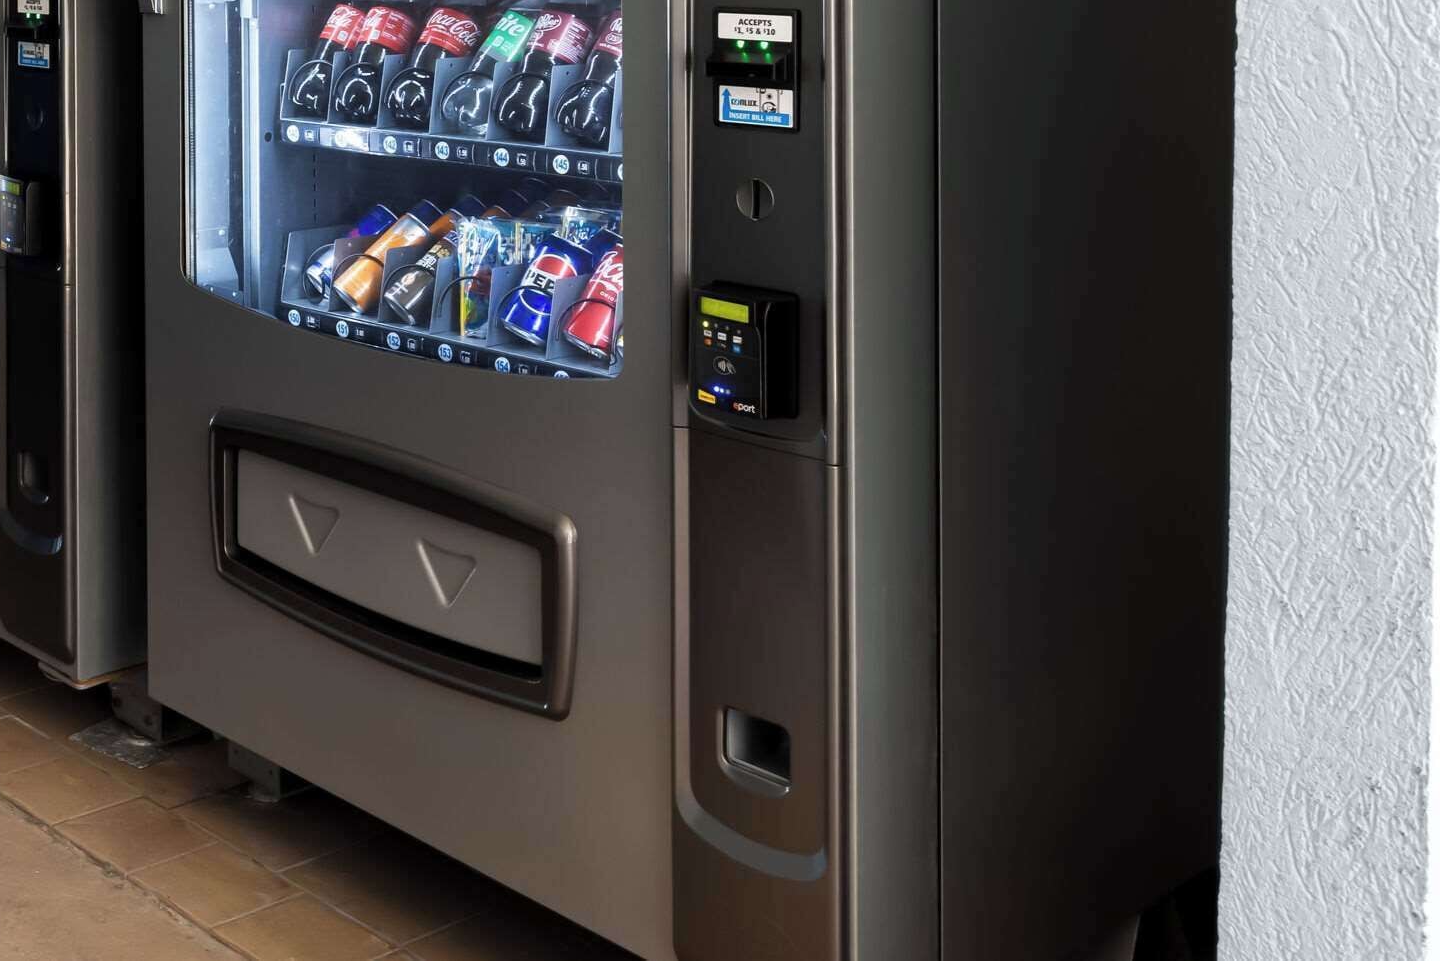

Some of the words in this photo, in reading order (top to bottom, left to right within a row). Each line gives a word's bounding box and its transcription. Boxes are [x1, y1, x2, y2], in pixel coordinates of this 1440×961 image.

[738, 18, 772, 27] ACCEPTS
[734, 27, 744, 35] $1,
[763, 28, 776, 36] $10
[729, 112, 750, 120] INSERT
[751, 114, 764, 122] BILL
[765, 115, 782, 123] HERE
[436, 146, 448, 157] 143
[495, 152, 509, 163] 144
[555, 159, 568, 170] 145
[337, 324, 348, 335] 151
[388, 335, 400, 347] 152
[439, 347, 451, 359] 153
[496, 361, 509, 373] 154
